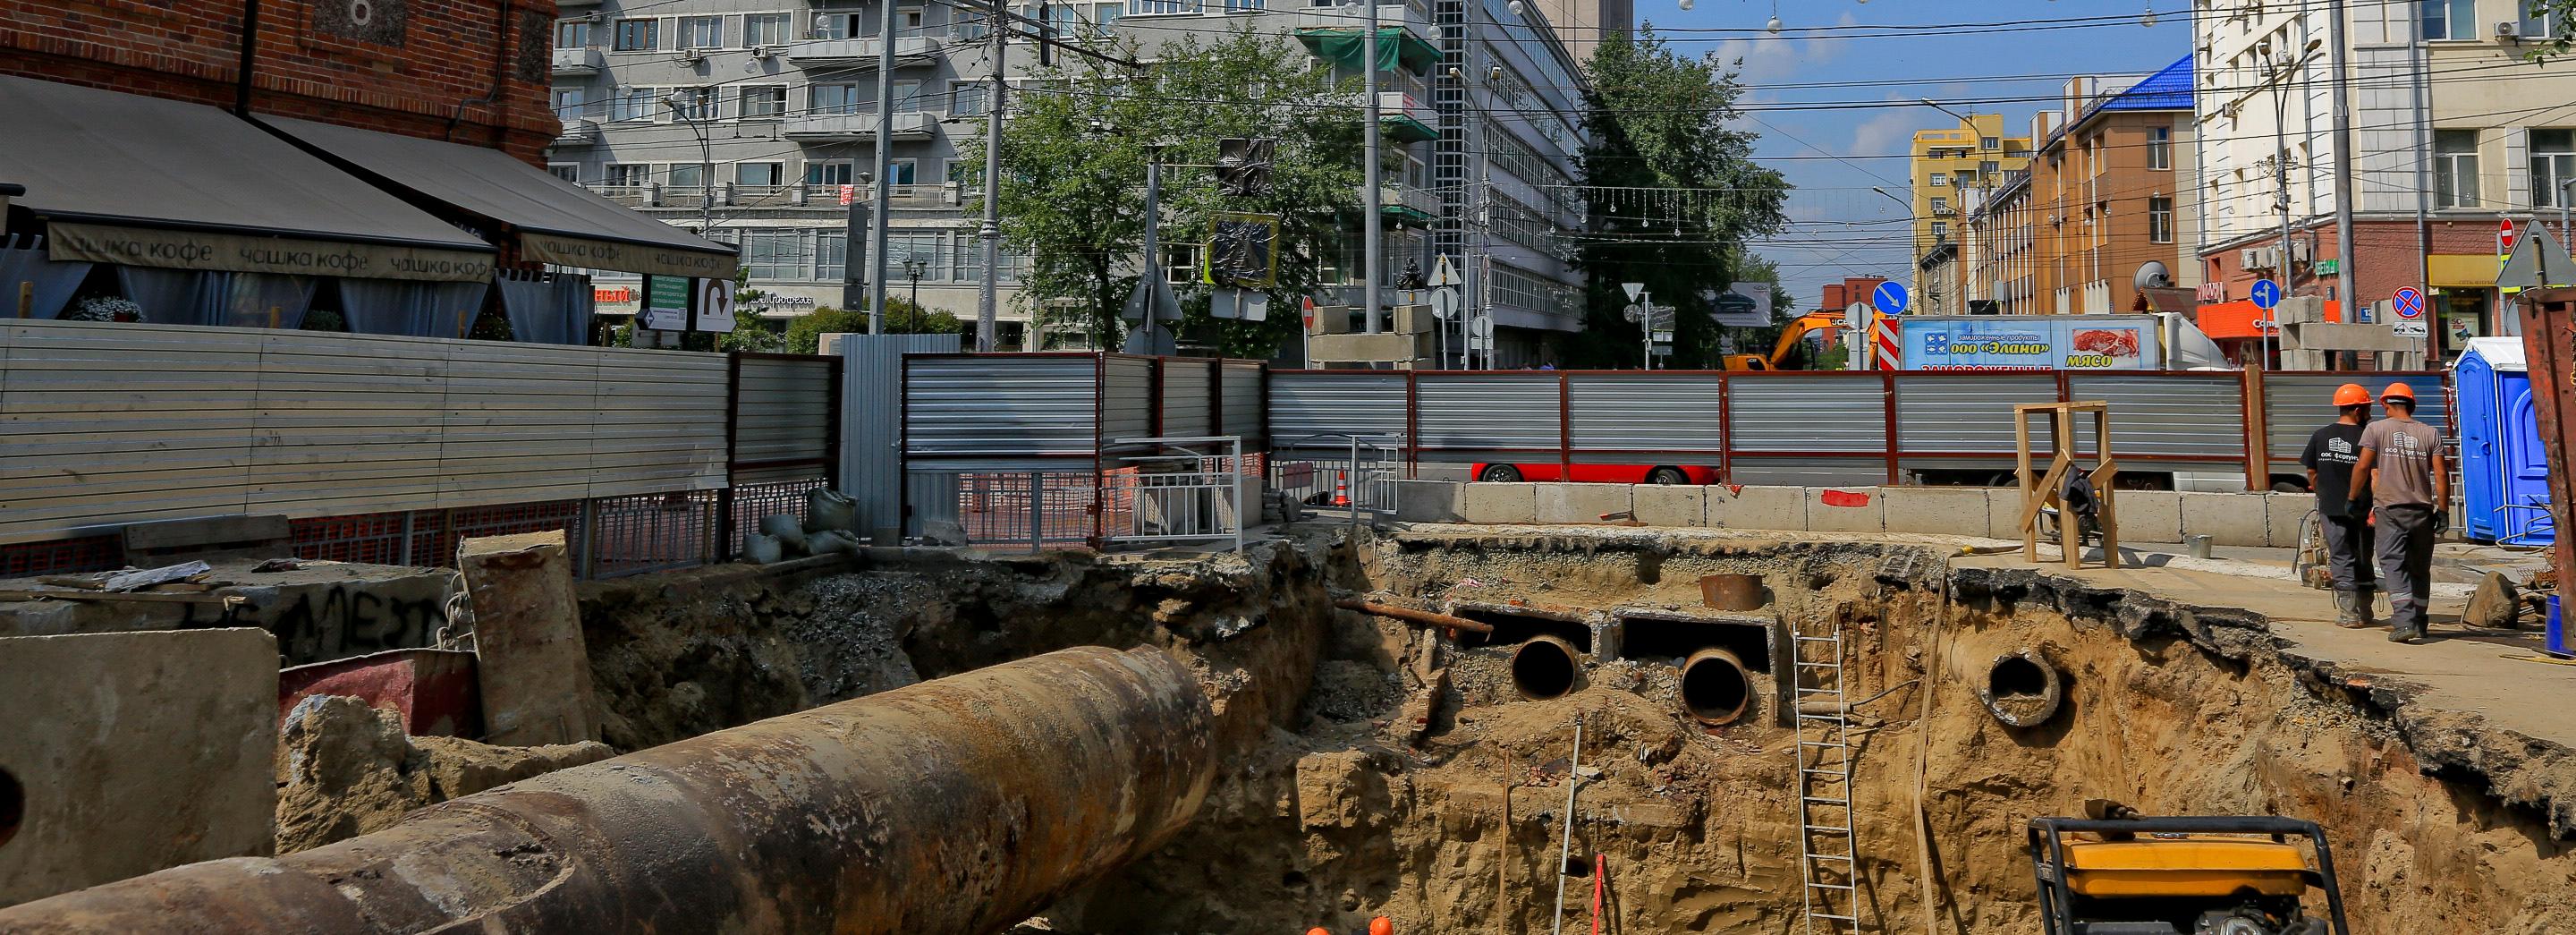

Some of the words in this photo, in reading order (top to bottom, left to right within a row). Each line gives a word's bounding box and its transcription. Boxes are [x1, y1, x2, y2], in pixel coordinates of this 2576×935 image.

[149, 238, 213, 266] кофе
[240, 247, 311, 267] чашка
[317, 250, 368, 274] кофе
[391, 256, 450, 274] чашка
[2006, 335, 2040, 343] продукты
